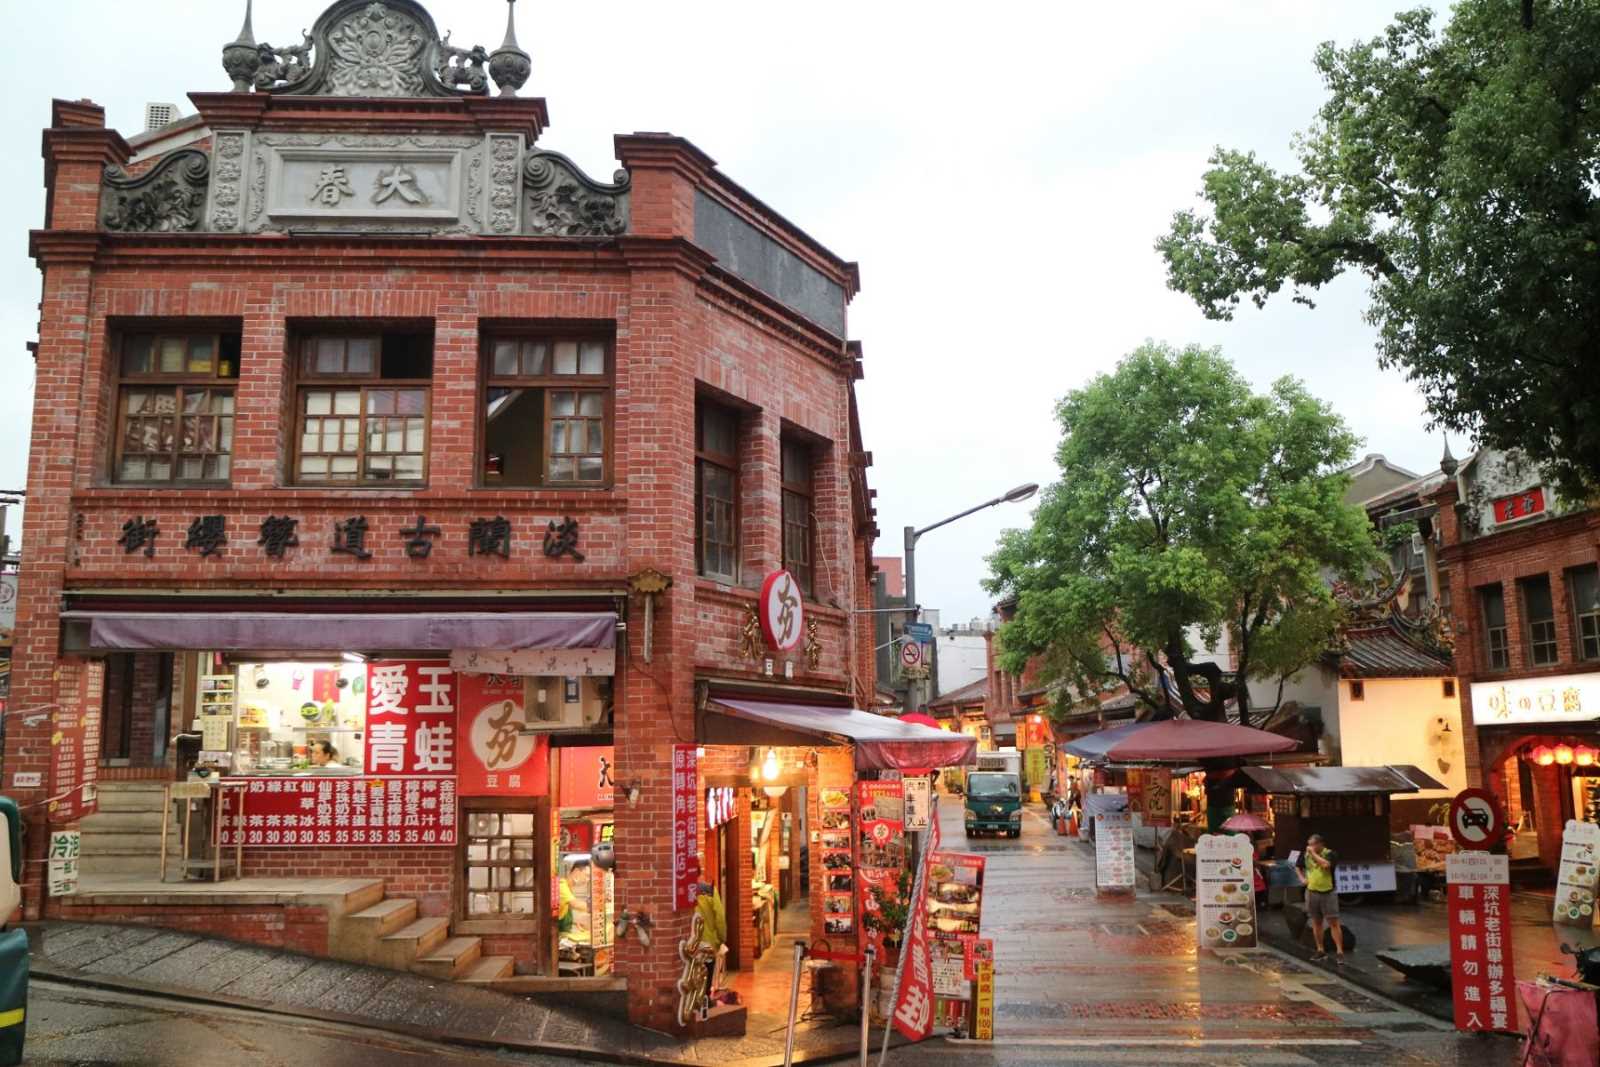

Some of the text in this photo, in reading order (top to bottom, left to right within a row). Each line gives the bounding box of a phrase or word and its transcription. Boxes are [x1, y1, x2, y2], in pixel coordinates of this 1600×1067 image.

[310, 163, 423, 207] 大春
[369, 664, 454, 715] 愛玉
[369, 721, 453, 772] 青蛙
[485, 774, 521, 788] 豆腐
[250, 781, 265, 827] 奶茶
[283, 781, 298, 827] 紅茶
[300, 781, 315, 827] 仙草冰
[335, 780, 350, 827] 珍珠奶茶
[249, 830, 263, 843] 30
[266, 830, 280, 843] 30
[283, 830, 297, 843] 30
[300, 830, 314, 843] 30
[317, 830, 331, 843] 35
[335, 830, 349, 843] 35
[352, 830, 365, 843] 35
[369, 830, 382, 843] 35
[387, 830, 401, 843] 35
[405, 830, 418, 843] 35
[422, 830, 436, 843] 40
[440, 830, 453, 843] 40
[1458, 886, 1483, 1028] 車輛請勿進入
